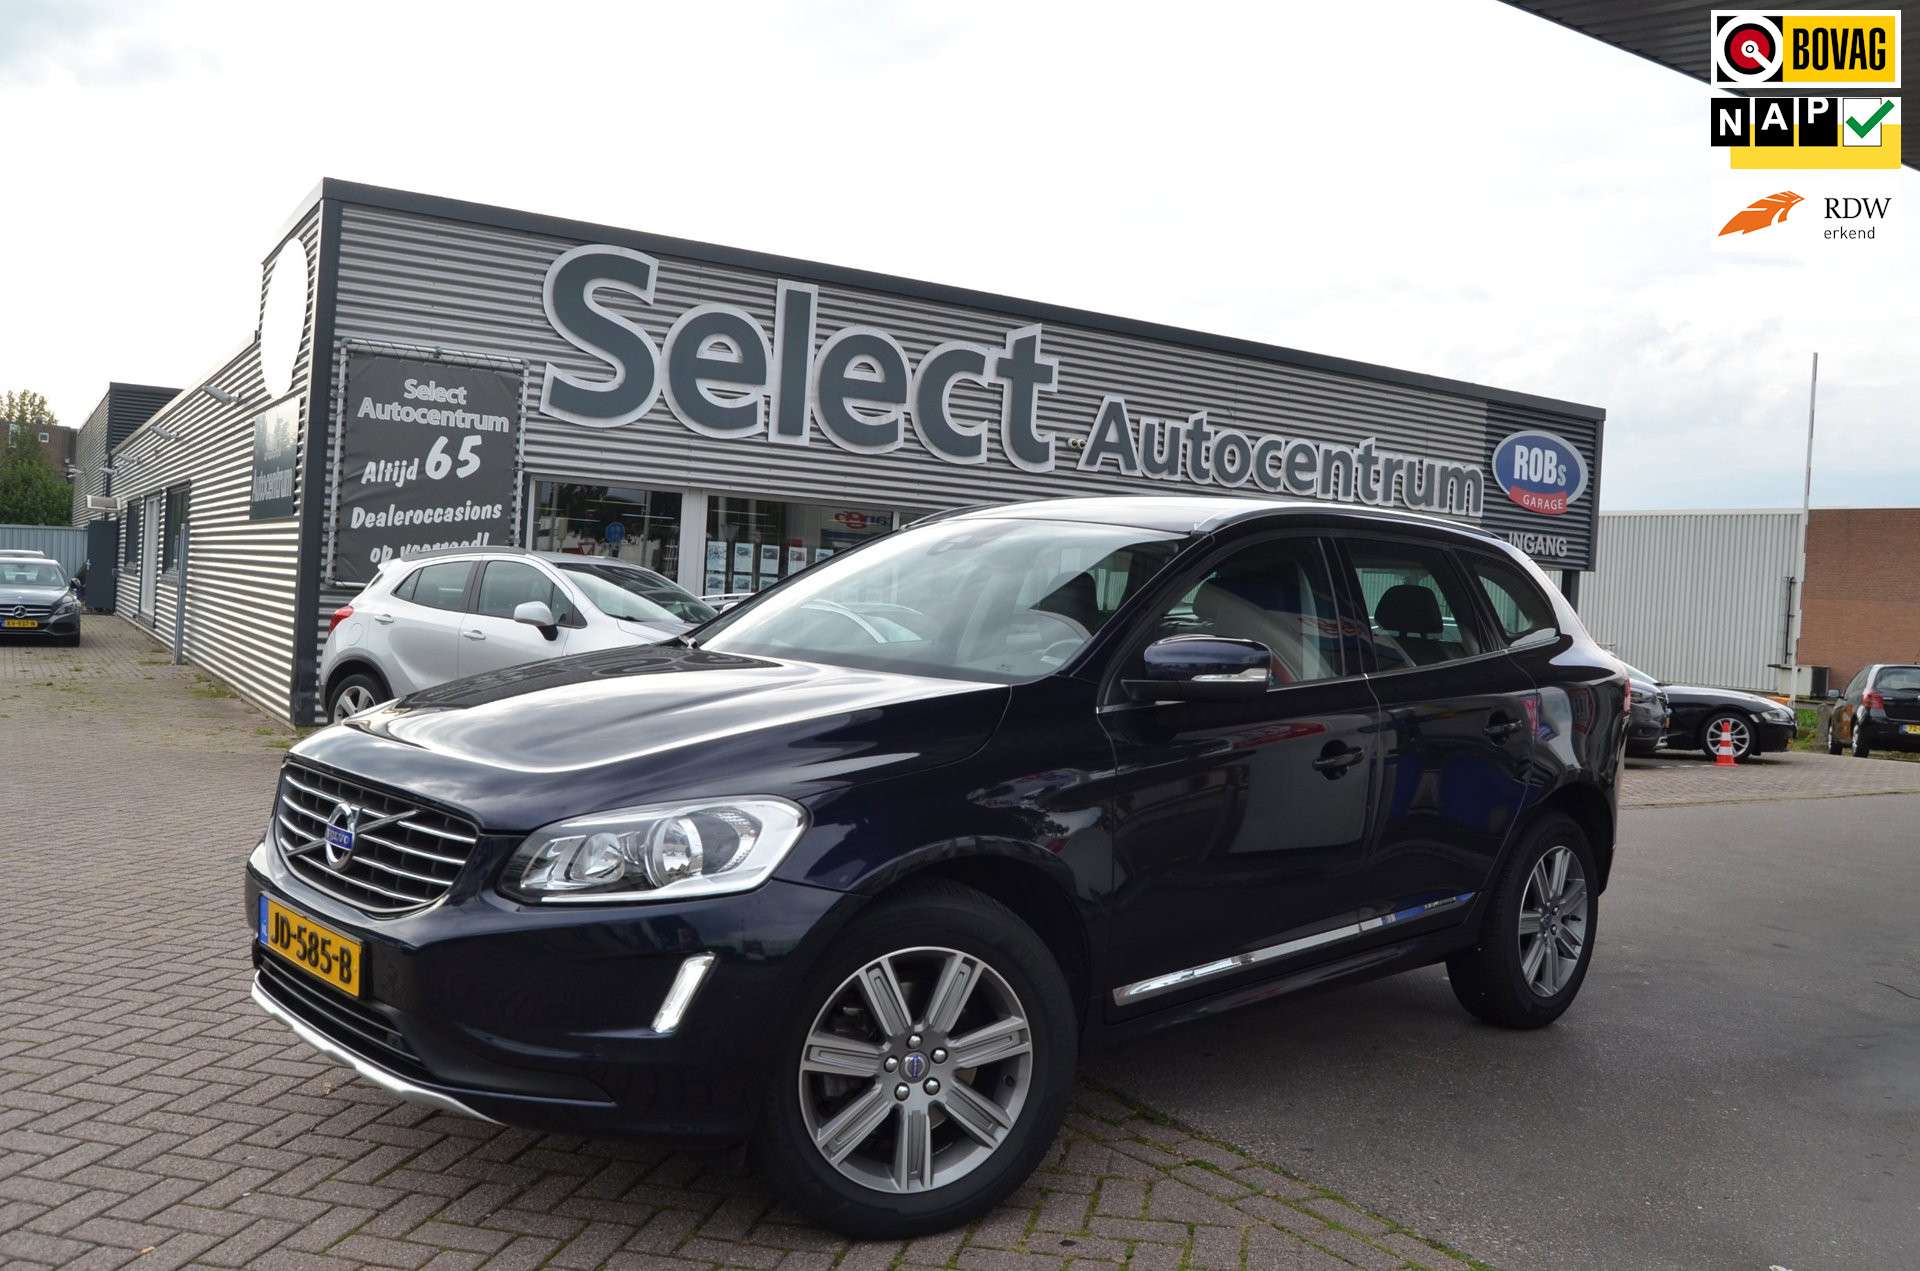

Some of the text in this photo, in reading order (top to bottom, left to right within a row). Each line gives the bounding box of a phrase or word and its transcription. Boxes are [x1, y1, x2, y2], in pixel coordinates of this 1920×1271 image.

[403, 378, 468, 405] Select
[540, 244, 1484, 518] Select Autocentrum
[356, 396, 510, 433] Autocentrum
[360, 434, 483, 488] Altijd 65
[1513, 444, 1567, 487] ROBs
[350, 500, 503, 530] Dealeroccasions
[1522, 494, 1563, 510] GARAGE
[270, 911, 352, 985] JD-585-B
